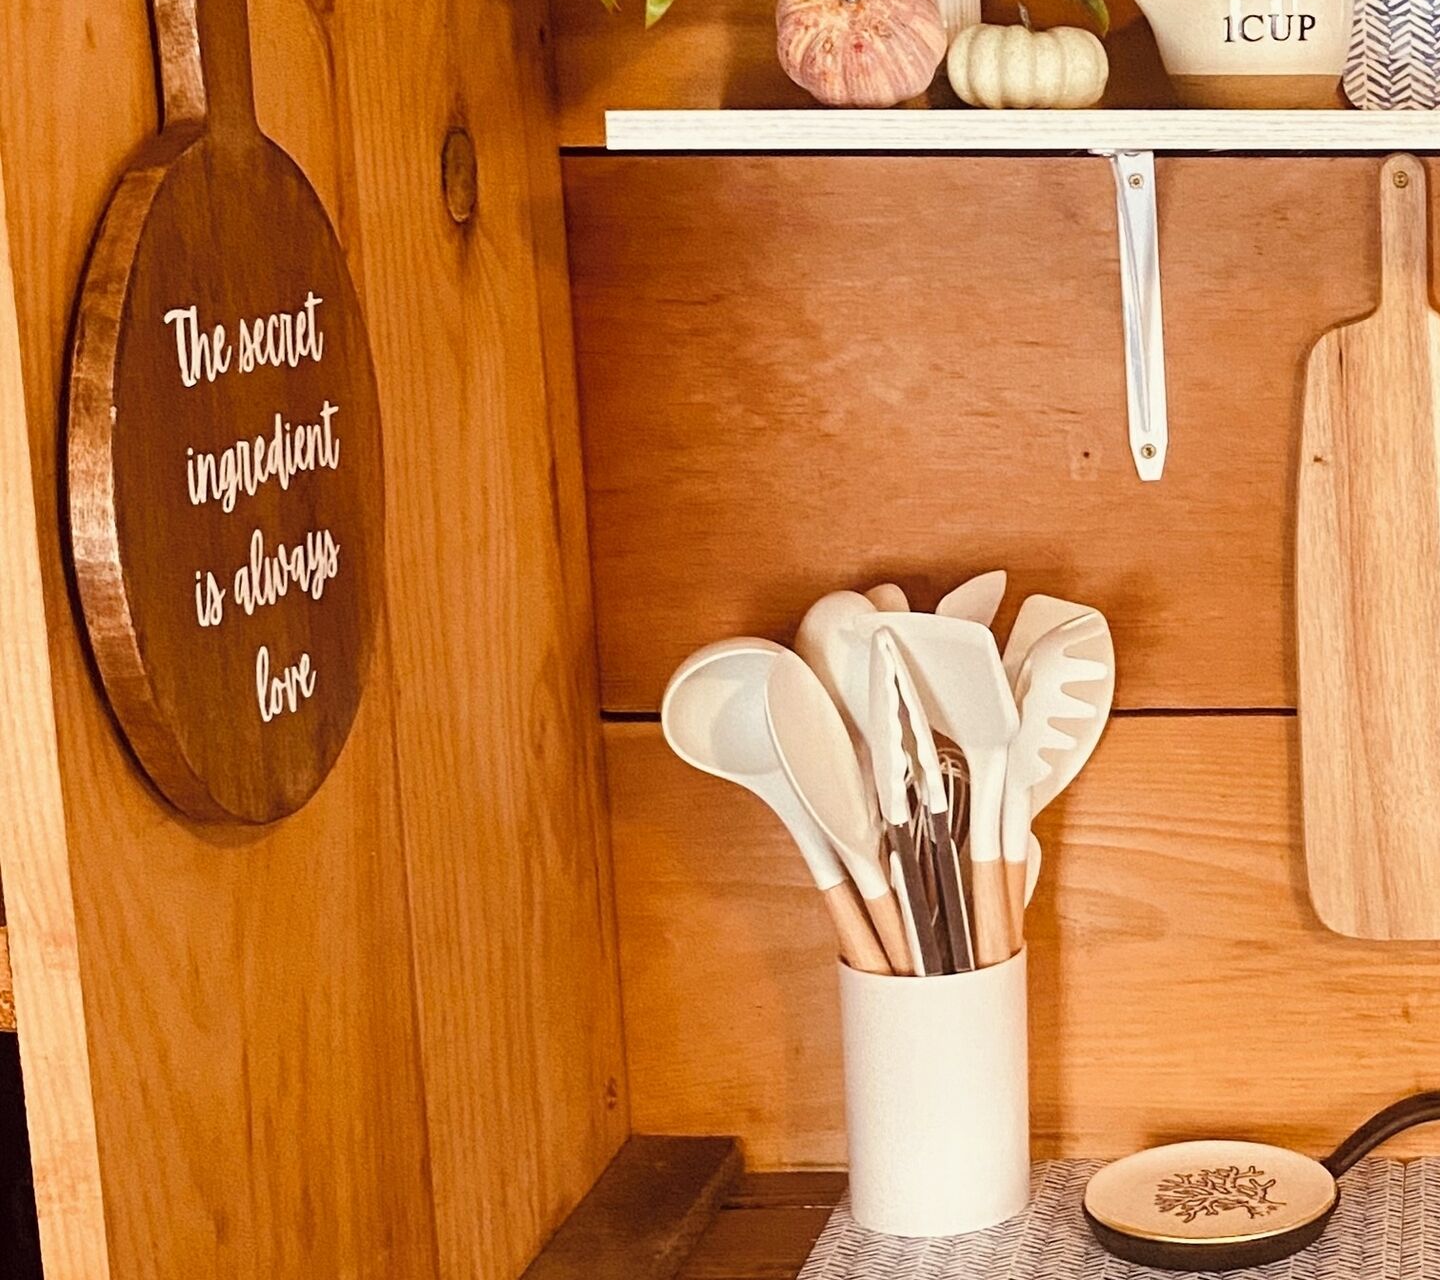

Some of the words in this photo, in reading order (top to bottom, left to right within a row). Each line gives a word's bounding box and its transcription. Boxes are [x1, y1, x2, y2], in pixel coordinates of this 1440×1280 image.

[164, 305, 232, 387] The
[239, 291, 323, 374] secret
[186, 400, 340, 513] ingredient
[195, 570, 226, 627] is
[234, 529, 340, 616] always
[255, 646, 317, 722] love
